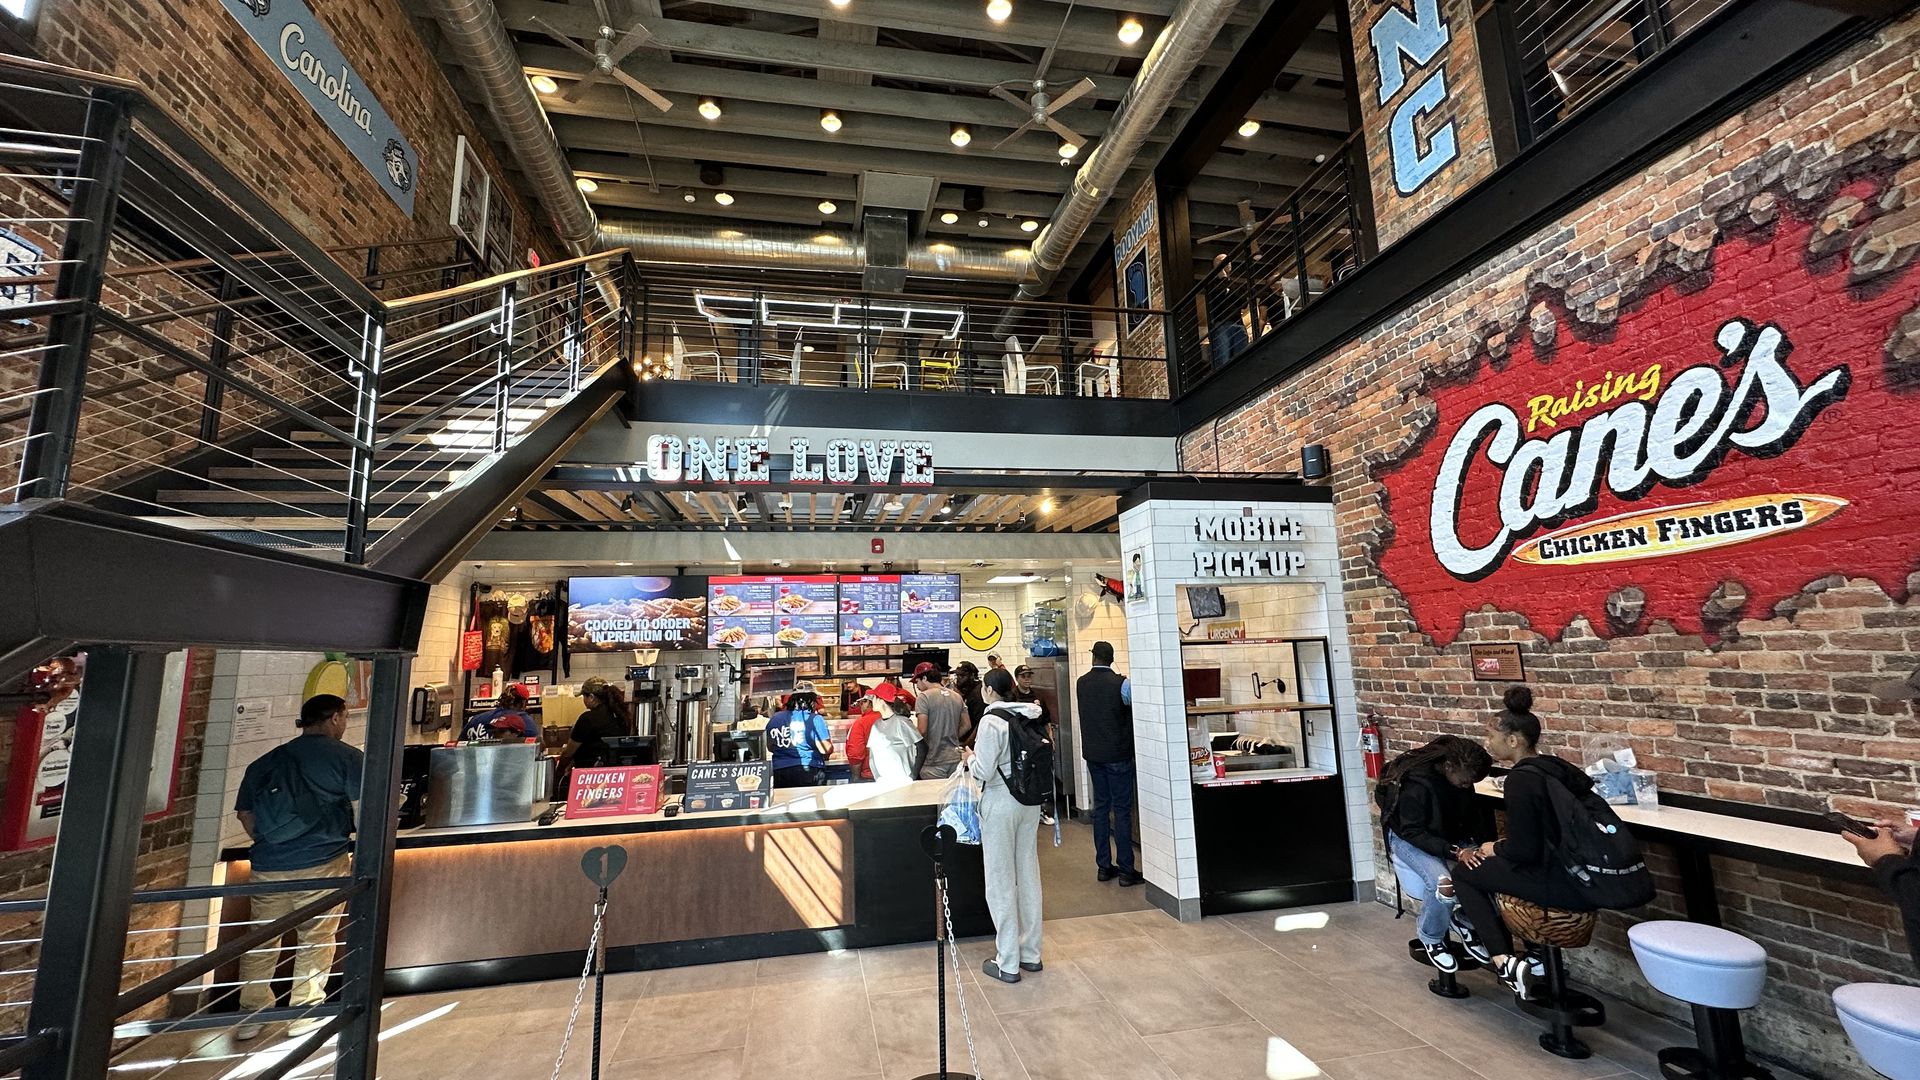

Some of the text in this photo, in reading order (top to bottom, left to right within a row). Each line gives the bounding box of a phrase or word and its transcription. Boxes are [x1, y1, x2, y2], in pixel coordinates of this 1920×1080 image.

[280, 22, 373, 136] Carolina
[1115, 200, 1153, 269] BOOYAH!
[1527, 363, 1662, 434] Raising
[647, 434, 935, 486] ONE LOVE
[1430, 318, 1848, 580] Cane's
[1196, 516, 1306, 541] MOBILE
[1538, 500, 1806, 560] CHICKEN FINGERS
[1193, 552, 1306, 577] PICK UP
[585, 618, 691, 632] COOKED TO ORDER
[592, 629, 684, 643] IN PREMIUM OIL
[1210, 626, 1245, 640] URGENCY
[770, 725, 791, 738] ONE
[577, 772, 626, 785] CHICKEN
[691, 767, 728, 779] CANE'S
[575, 787, 624, 800] FINGERS
[599, 852, 609, 880] 1
